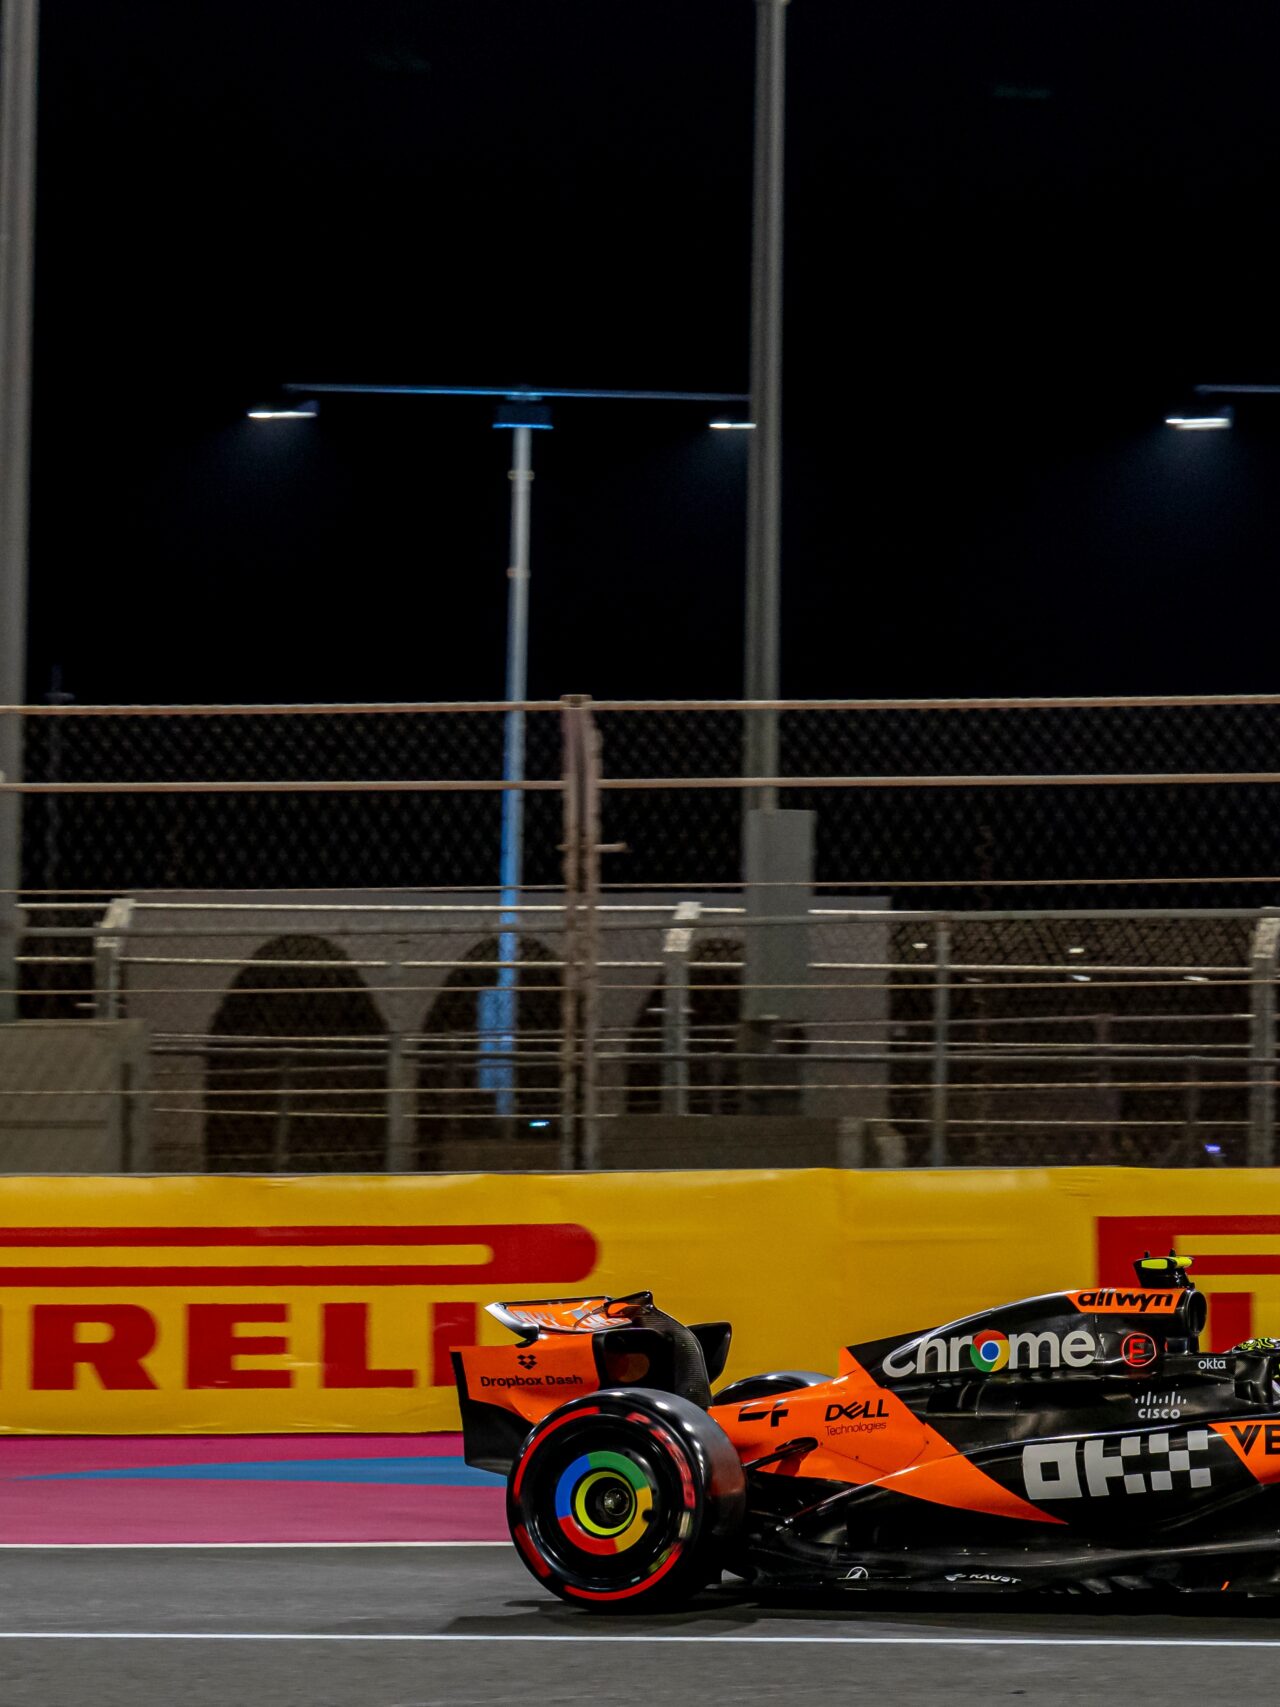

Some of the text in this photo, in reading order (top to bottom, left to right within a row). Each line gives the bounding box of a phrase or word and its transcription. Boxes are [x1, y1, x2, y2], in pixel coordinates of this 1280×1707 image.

[0, 1223, 598, 1390] PRELL
[1077, 1289, 1174, 1312] allwyn
[882, 1329, 1096, 1378] chrome
[1198, 1358, 1227, 1370] okta
[480, 1374, 583, 1389] Dropbox Dash
[824, 1399, 889, 1421] DELL
[825, 1422, 886, 1437] Technologies
[1023, 1429, 1212, 1499] OKX
[969, 1573, 1022, 1585] KAUST
